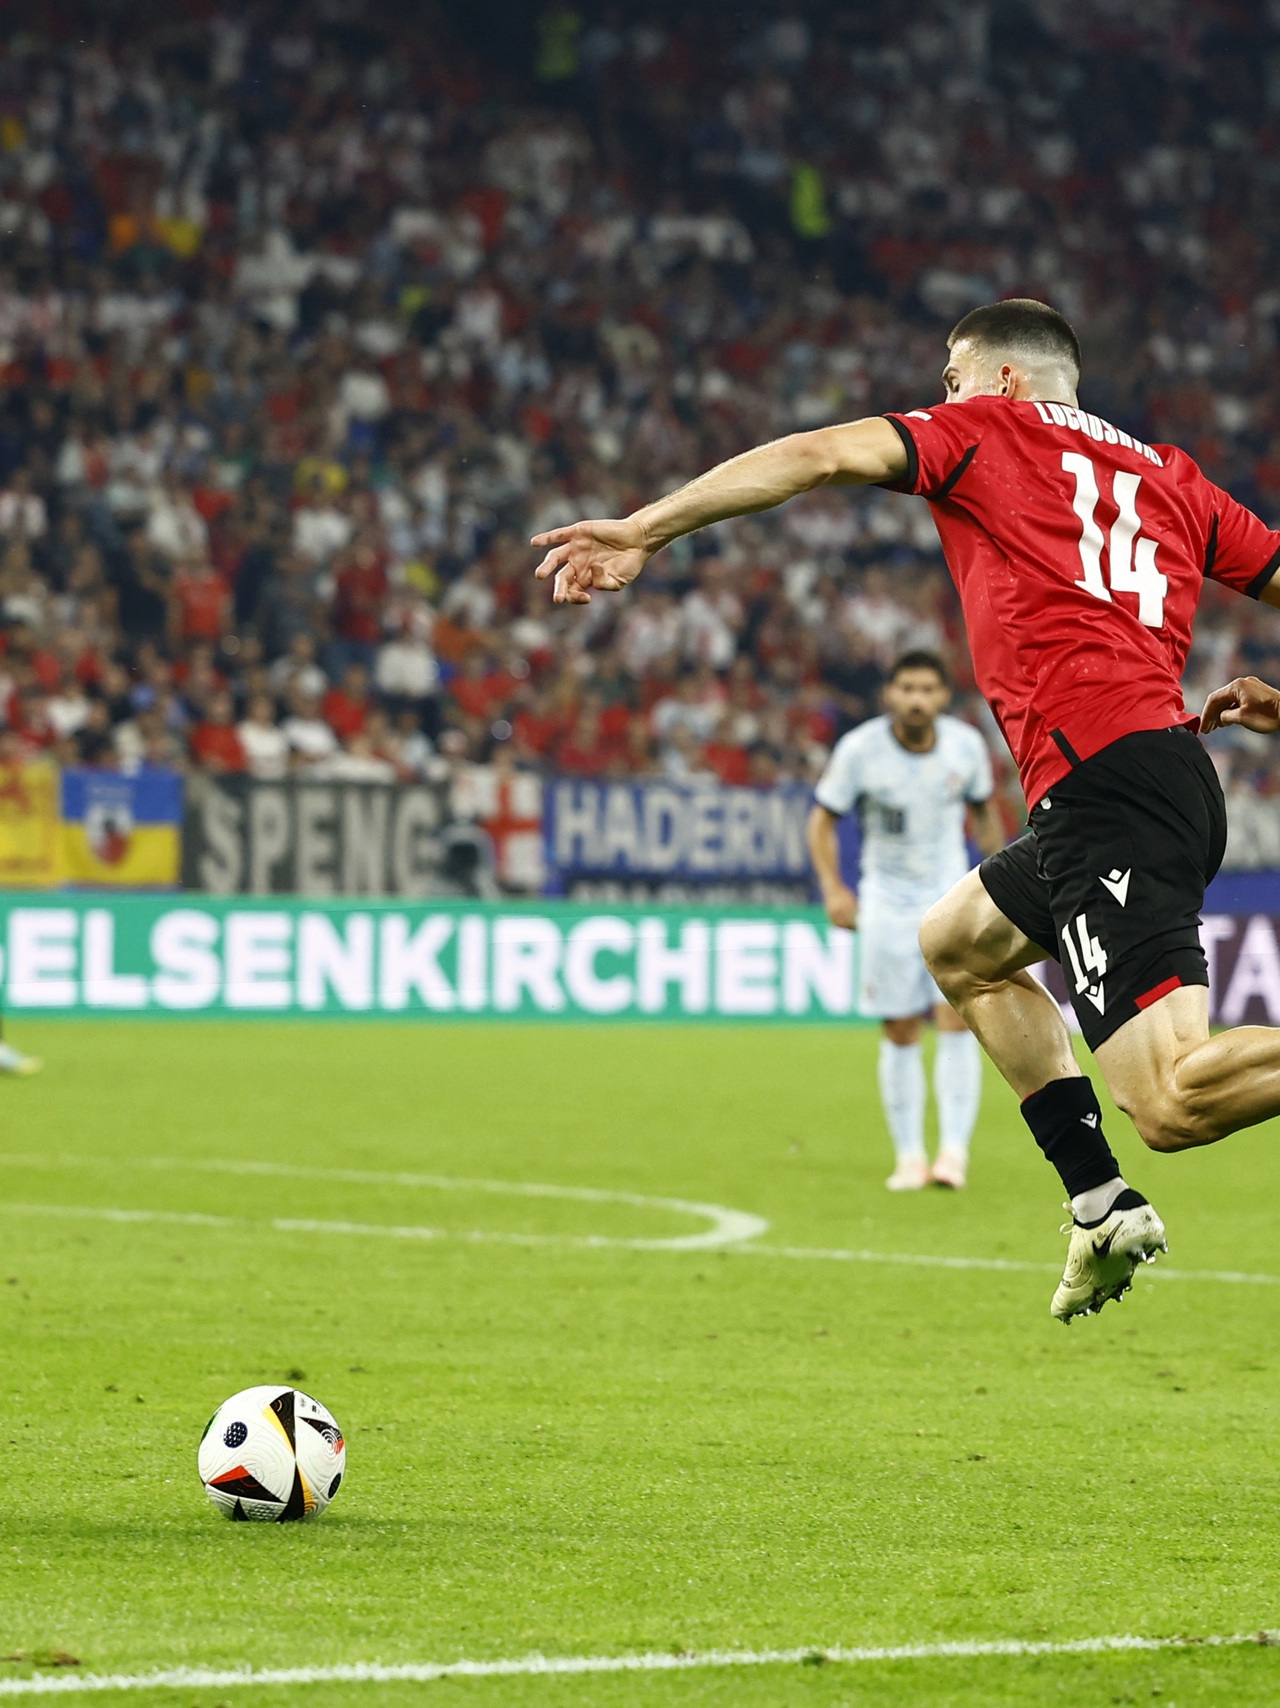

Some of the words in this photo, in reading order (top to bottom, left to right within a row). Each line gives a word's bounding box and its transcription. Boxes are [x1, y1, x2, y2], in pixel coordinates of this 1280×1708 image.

[1061, 452, 1168, 628] 14
[0, 908, 855, 1014] ELSENKIRCHEN
[1062, 913, 1108, 995] 14
